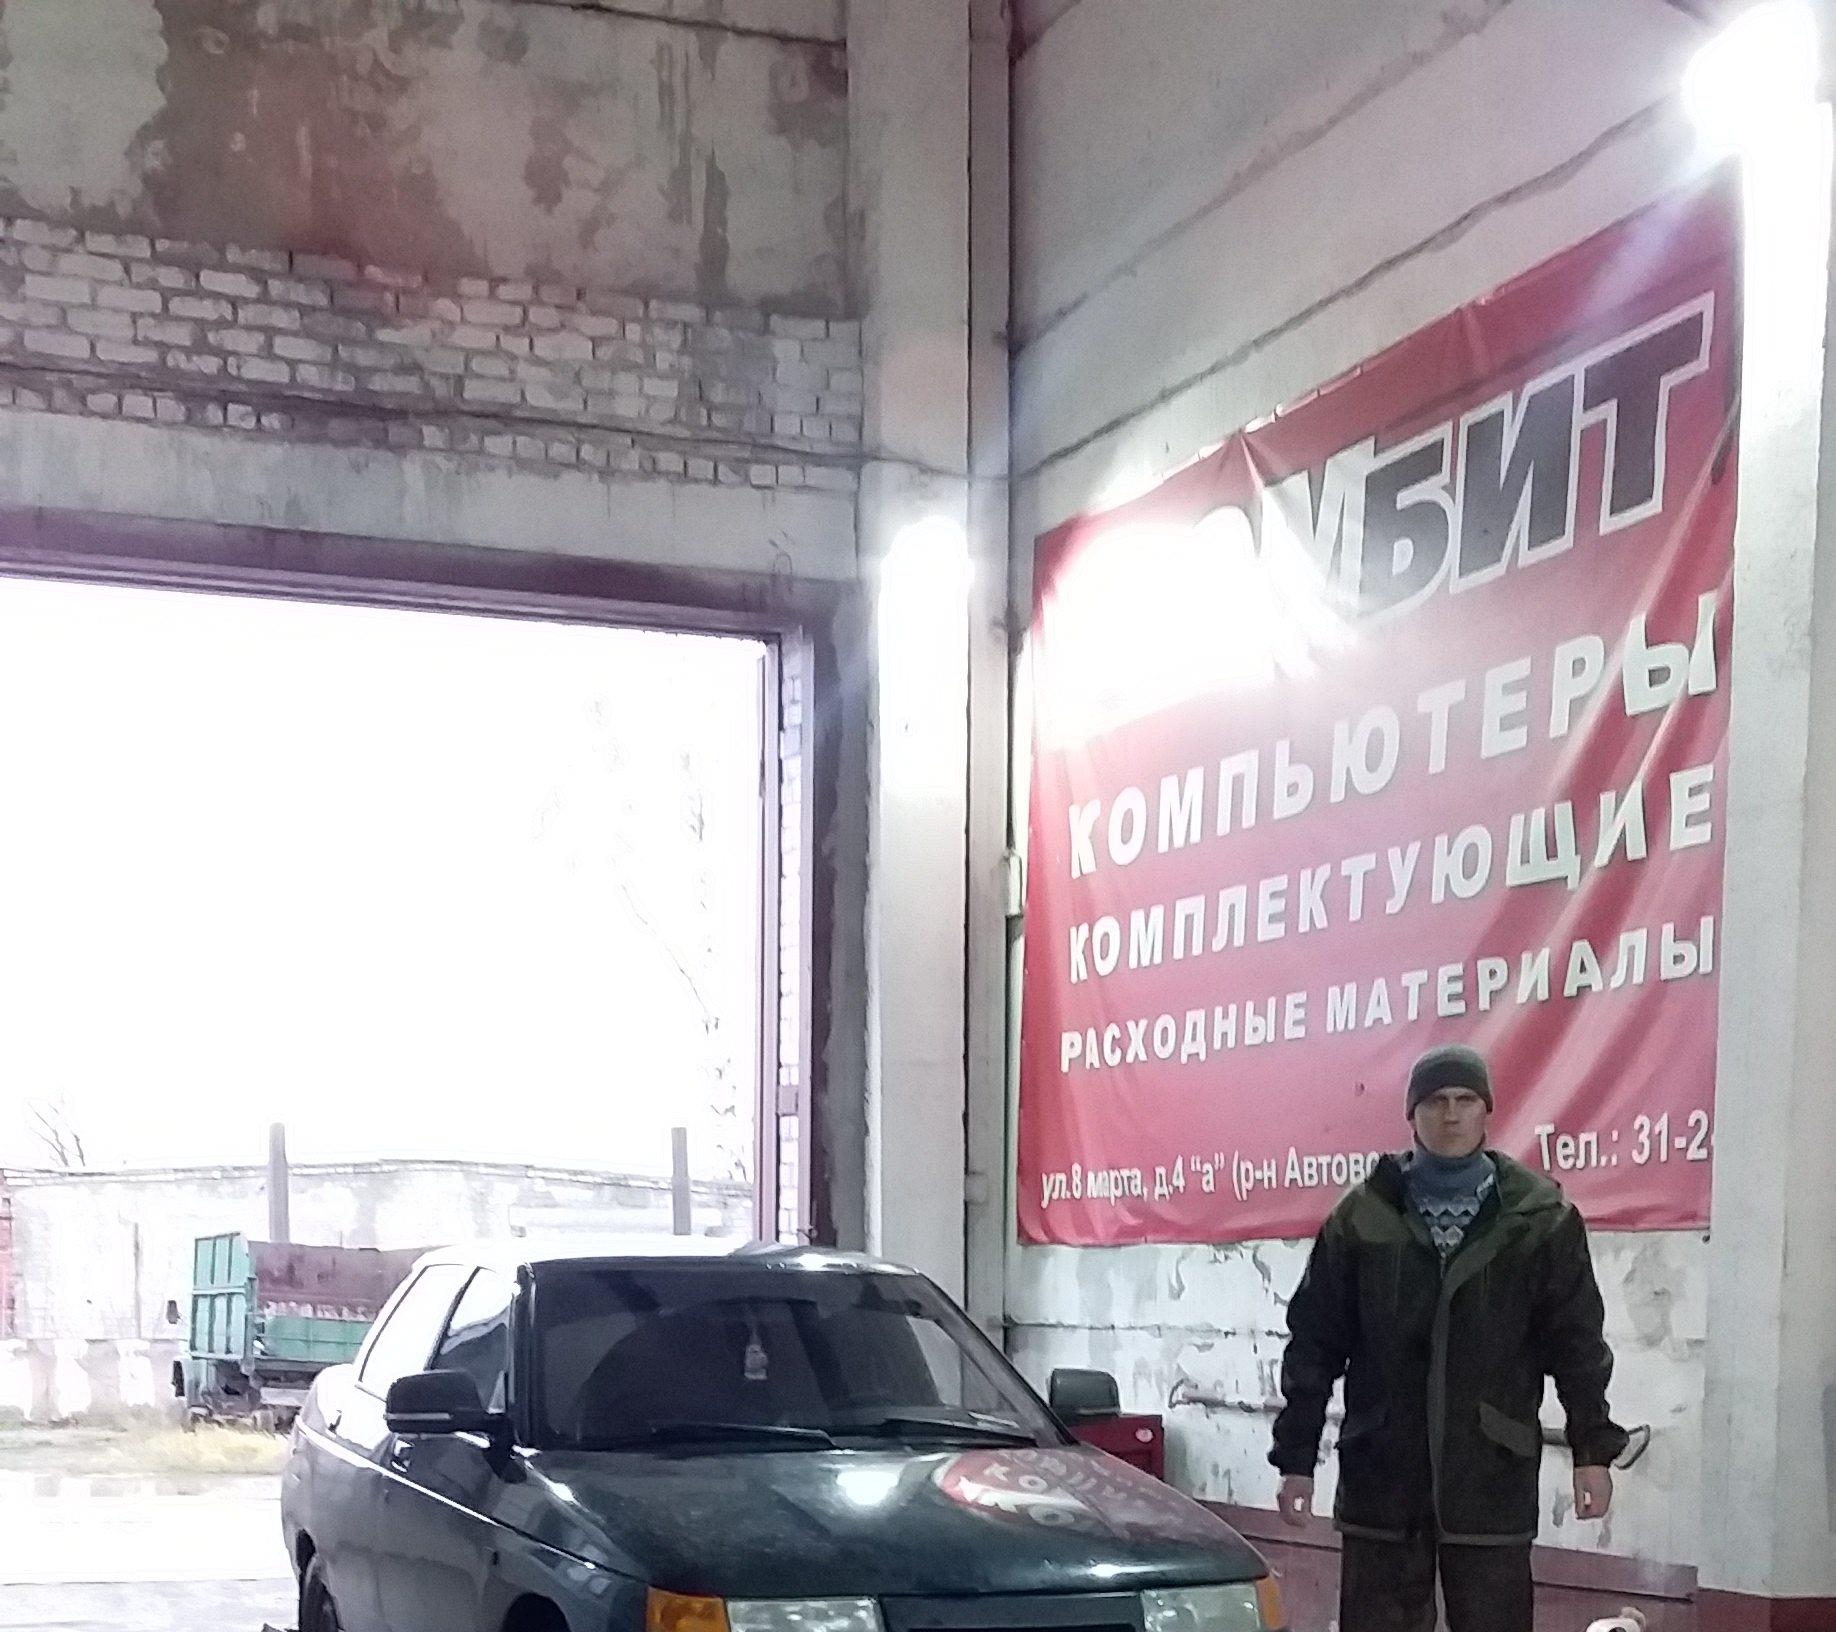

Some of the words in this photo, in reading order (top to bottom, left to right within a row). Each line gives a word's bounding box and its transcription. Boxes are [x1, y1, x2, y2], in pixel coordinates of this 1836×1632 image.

[1068, 592, 1718, 880] КОМПЬЮТЕРЫ
[1068, 765, 1715, 983] КОМПЛЕКТУЮЩИЕ
[1060, 992, 1306, 1073] РАСХОДНЫЕ
[1326, 914, 1715, 1032] МАТЕРИАЛЫ
[1087, 1167, 1148, 1206] марта,
[1232, 1150, 1277, 1200] (р-н
[1534, 1123, 1618, 1171] Тел.:
[1631, 1109, 1714, 1165] 31-2
